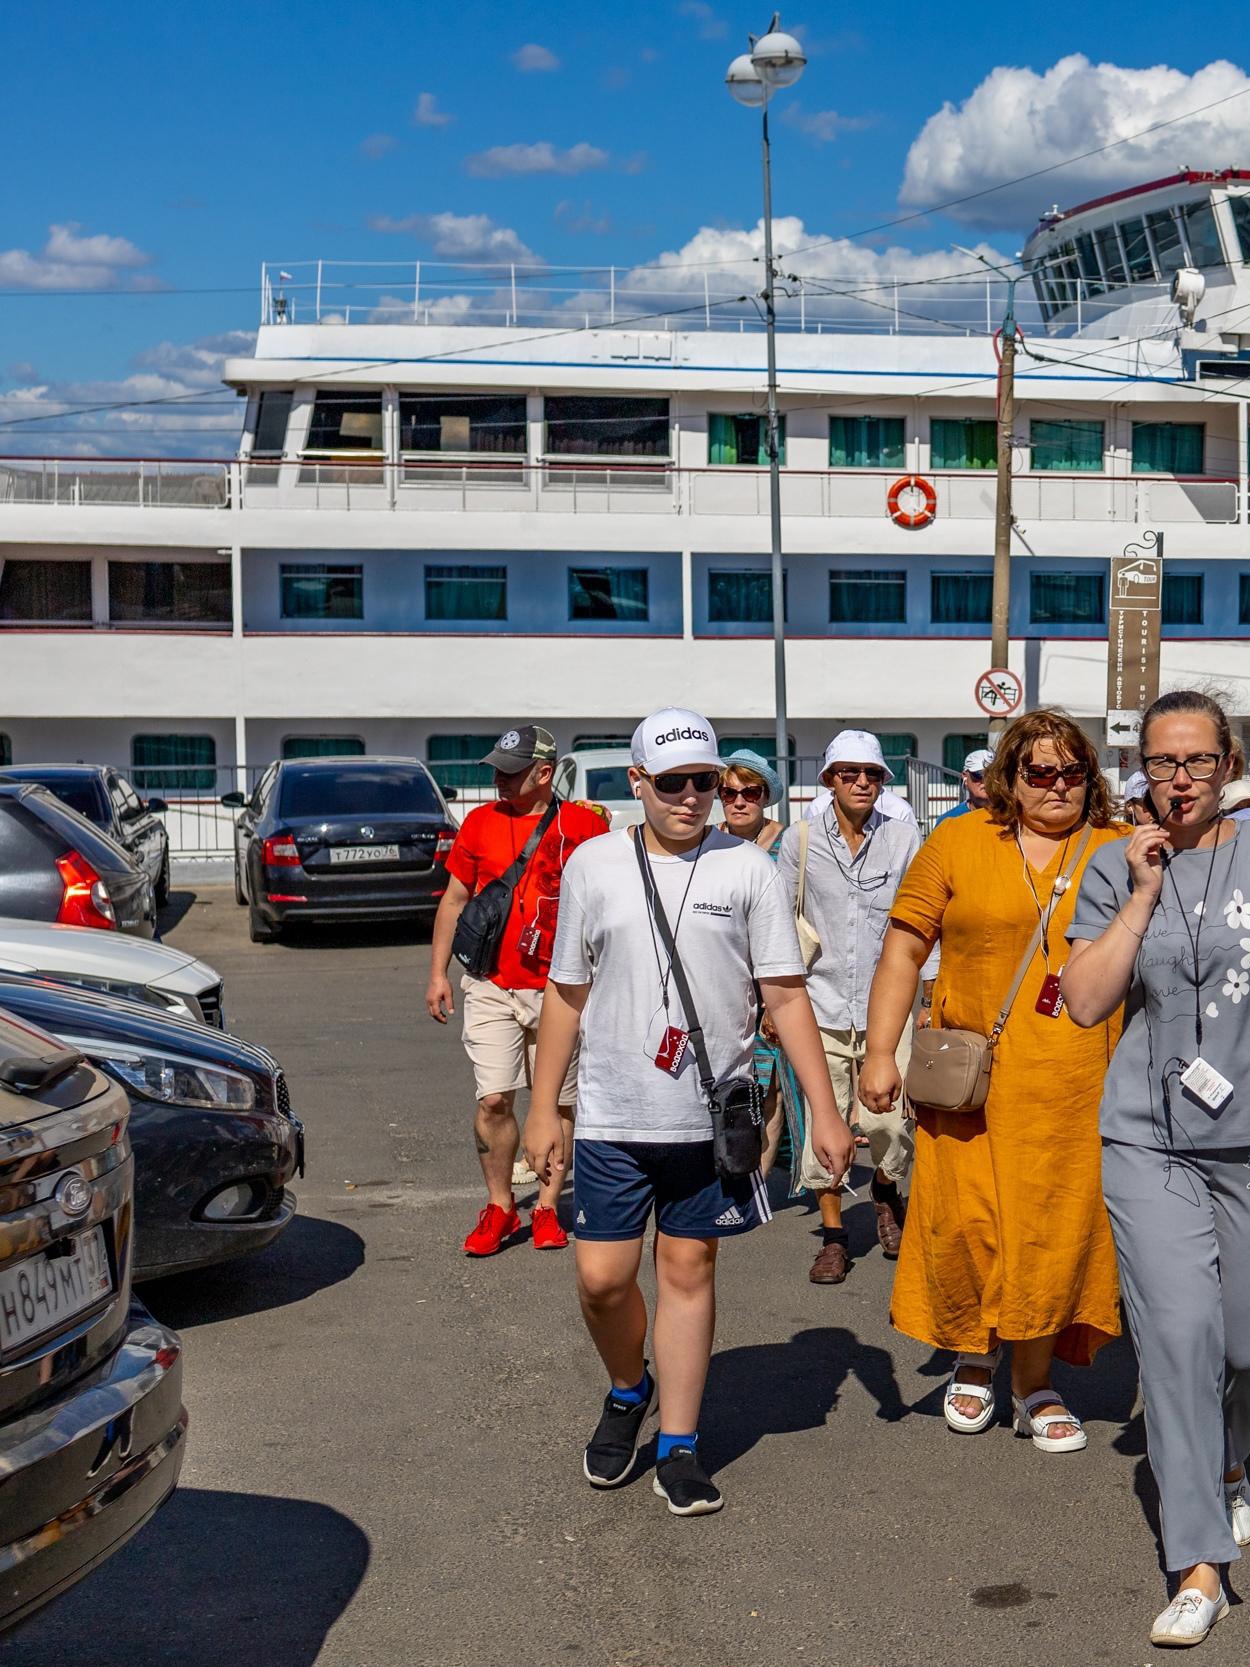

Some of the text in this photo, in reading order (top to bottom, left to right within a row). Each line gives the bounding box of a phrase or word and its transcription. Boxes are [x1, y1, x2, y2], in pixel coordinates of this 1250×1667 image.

[655, 727, 709, 746] adidas
[693, 902, 722, 912] adidas
[670, 1033, 689, 1073] ВОДОХОД
[715, 1216, 744, 1226] adidas
